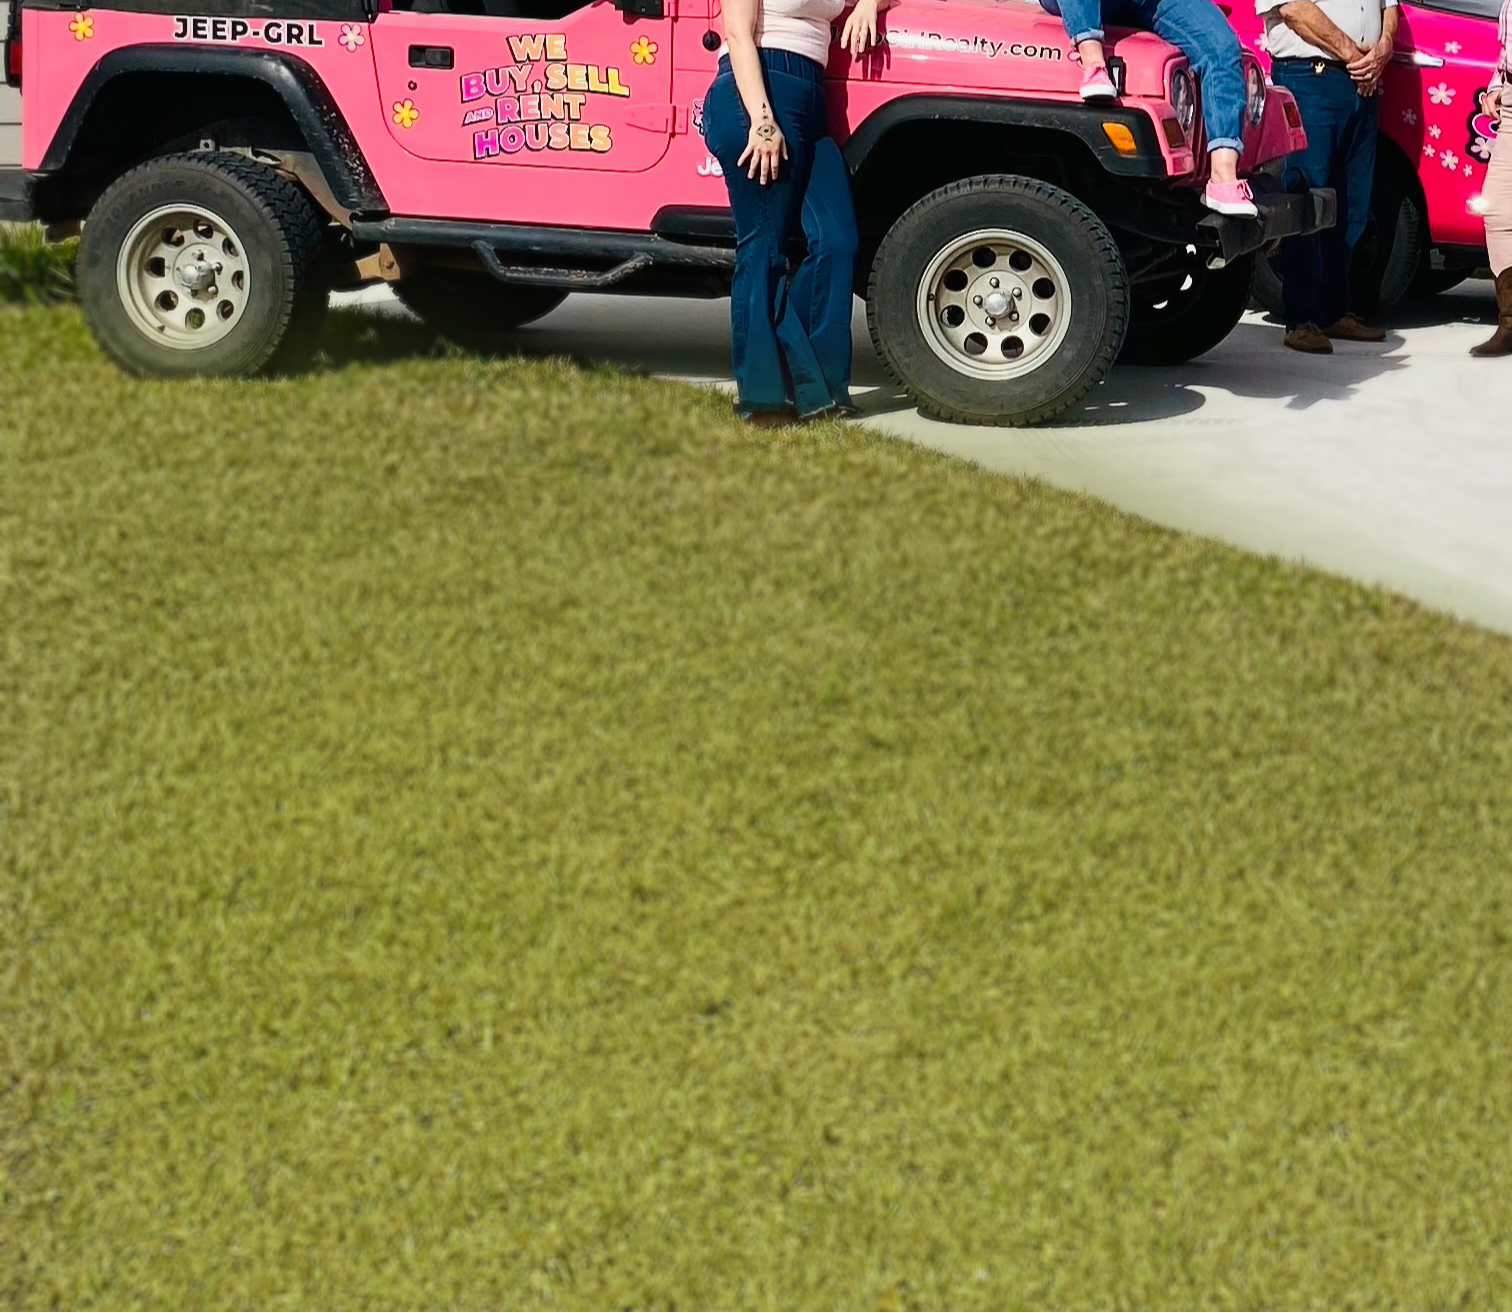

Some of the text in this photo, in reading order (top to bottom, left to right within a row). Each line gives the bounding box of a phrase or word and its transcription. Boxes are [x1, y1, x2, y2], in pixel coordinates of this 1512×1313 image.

[174, 17, 323, 46] JEEP-GRL
[506, 33, 568, 63] WE
[461, 63, 631, 104] BUY, SELL
[462, 92, 586, 127] AND RENT
[474, 122, 613, 161] HOUSES
